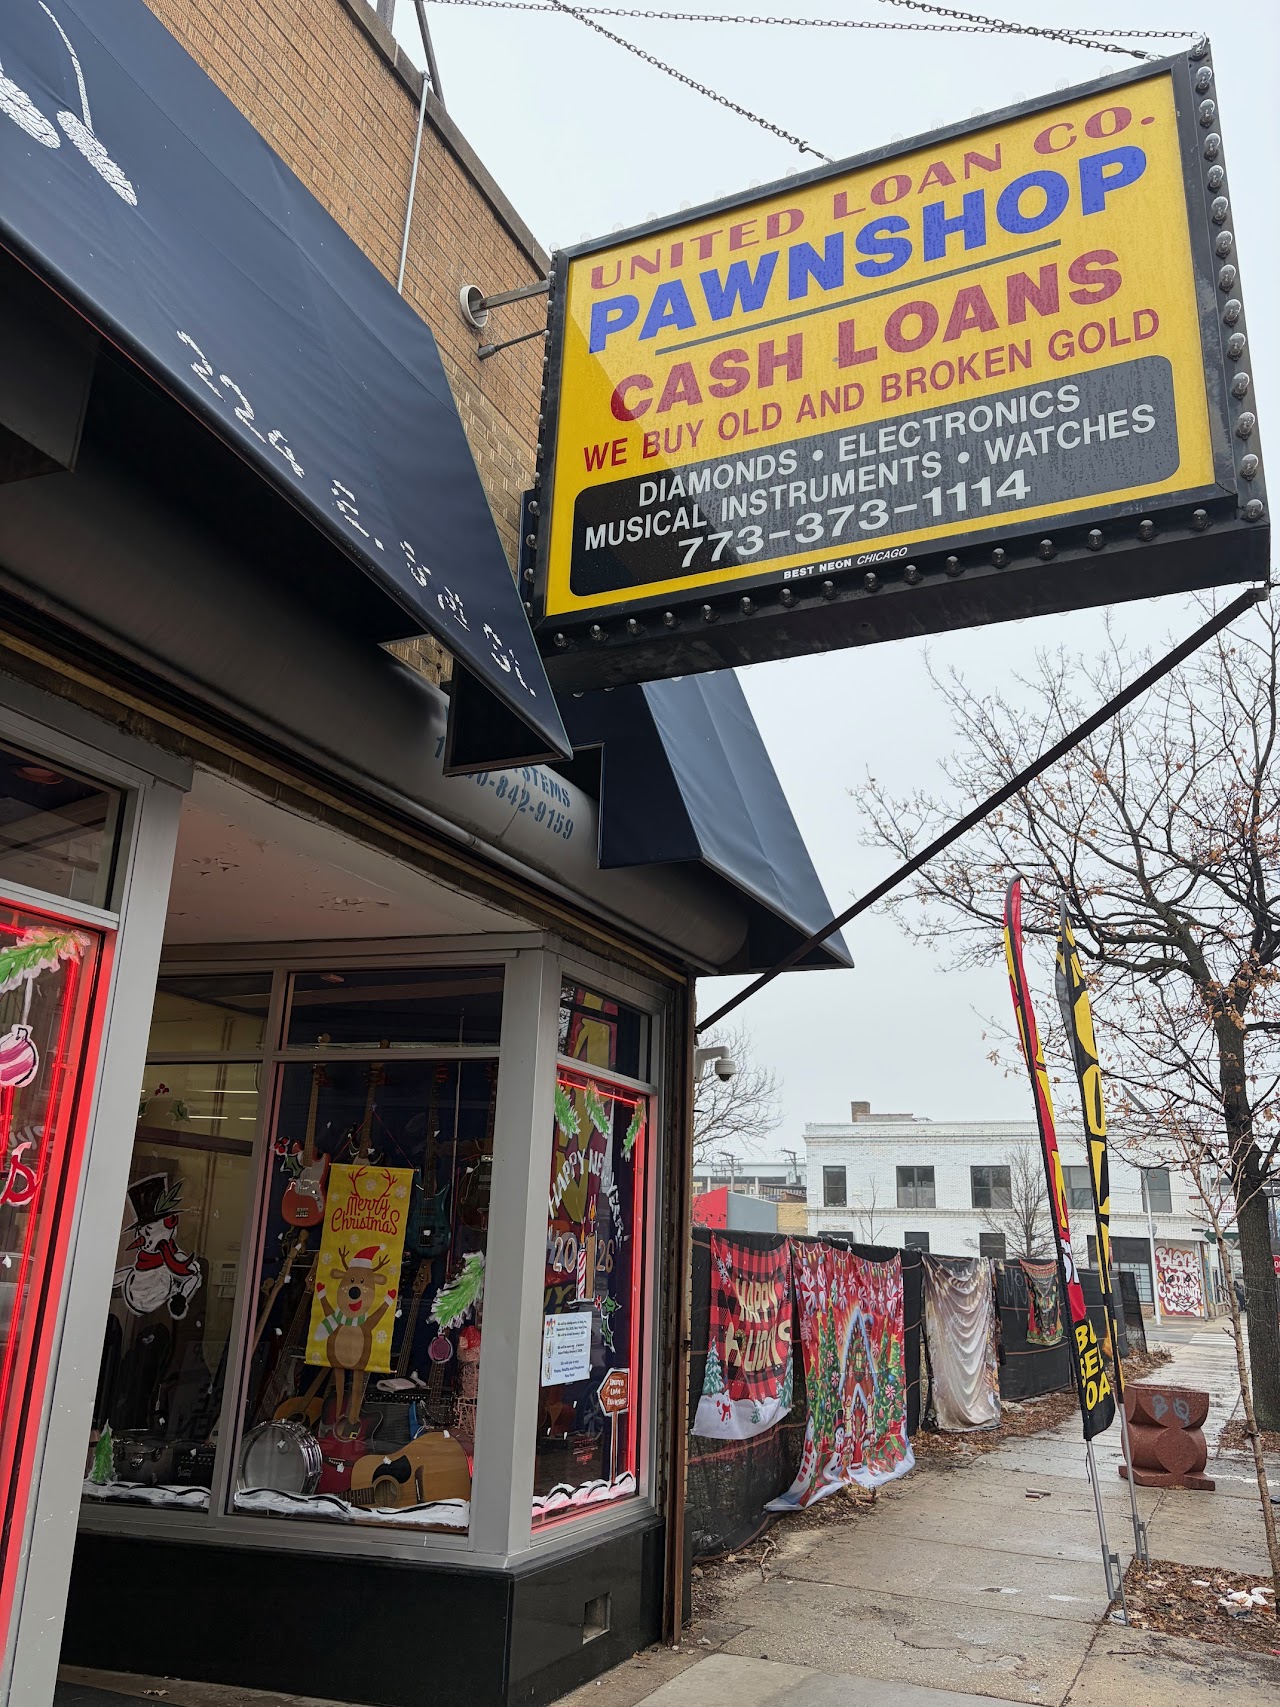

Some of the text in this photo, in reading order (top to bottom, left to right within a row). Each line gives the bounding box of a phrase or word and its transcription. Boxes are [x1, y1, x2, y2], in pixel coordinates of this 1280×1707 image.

[589, 145, 1147, 354] PAWNSHOP
[591, 106, 1155, 289] UNITED LOAN CO.
[584, 308, 1159, 473] WE BUY OLD AND BROKEN GOLD
[610, 249, 1122, 422] CASH LOANS
[585, 403, 1156, 551] MUSICAL INSTRUMENTS WATCHES
[639, 384, 1081, 507] DIAMONDS ELECTRONICS
[678, 469, 1031, 568] 773-373-1114
[783, 546, 908, 580] BEST NEON CHICAGO
[514, 766, 571, 808] STEMS
[345, 1195, 391, 1221] Merry
[548, 1148, 586, 1220] HAPPY
